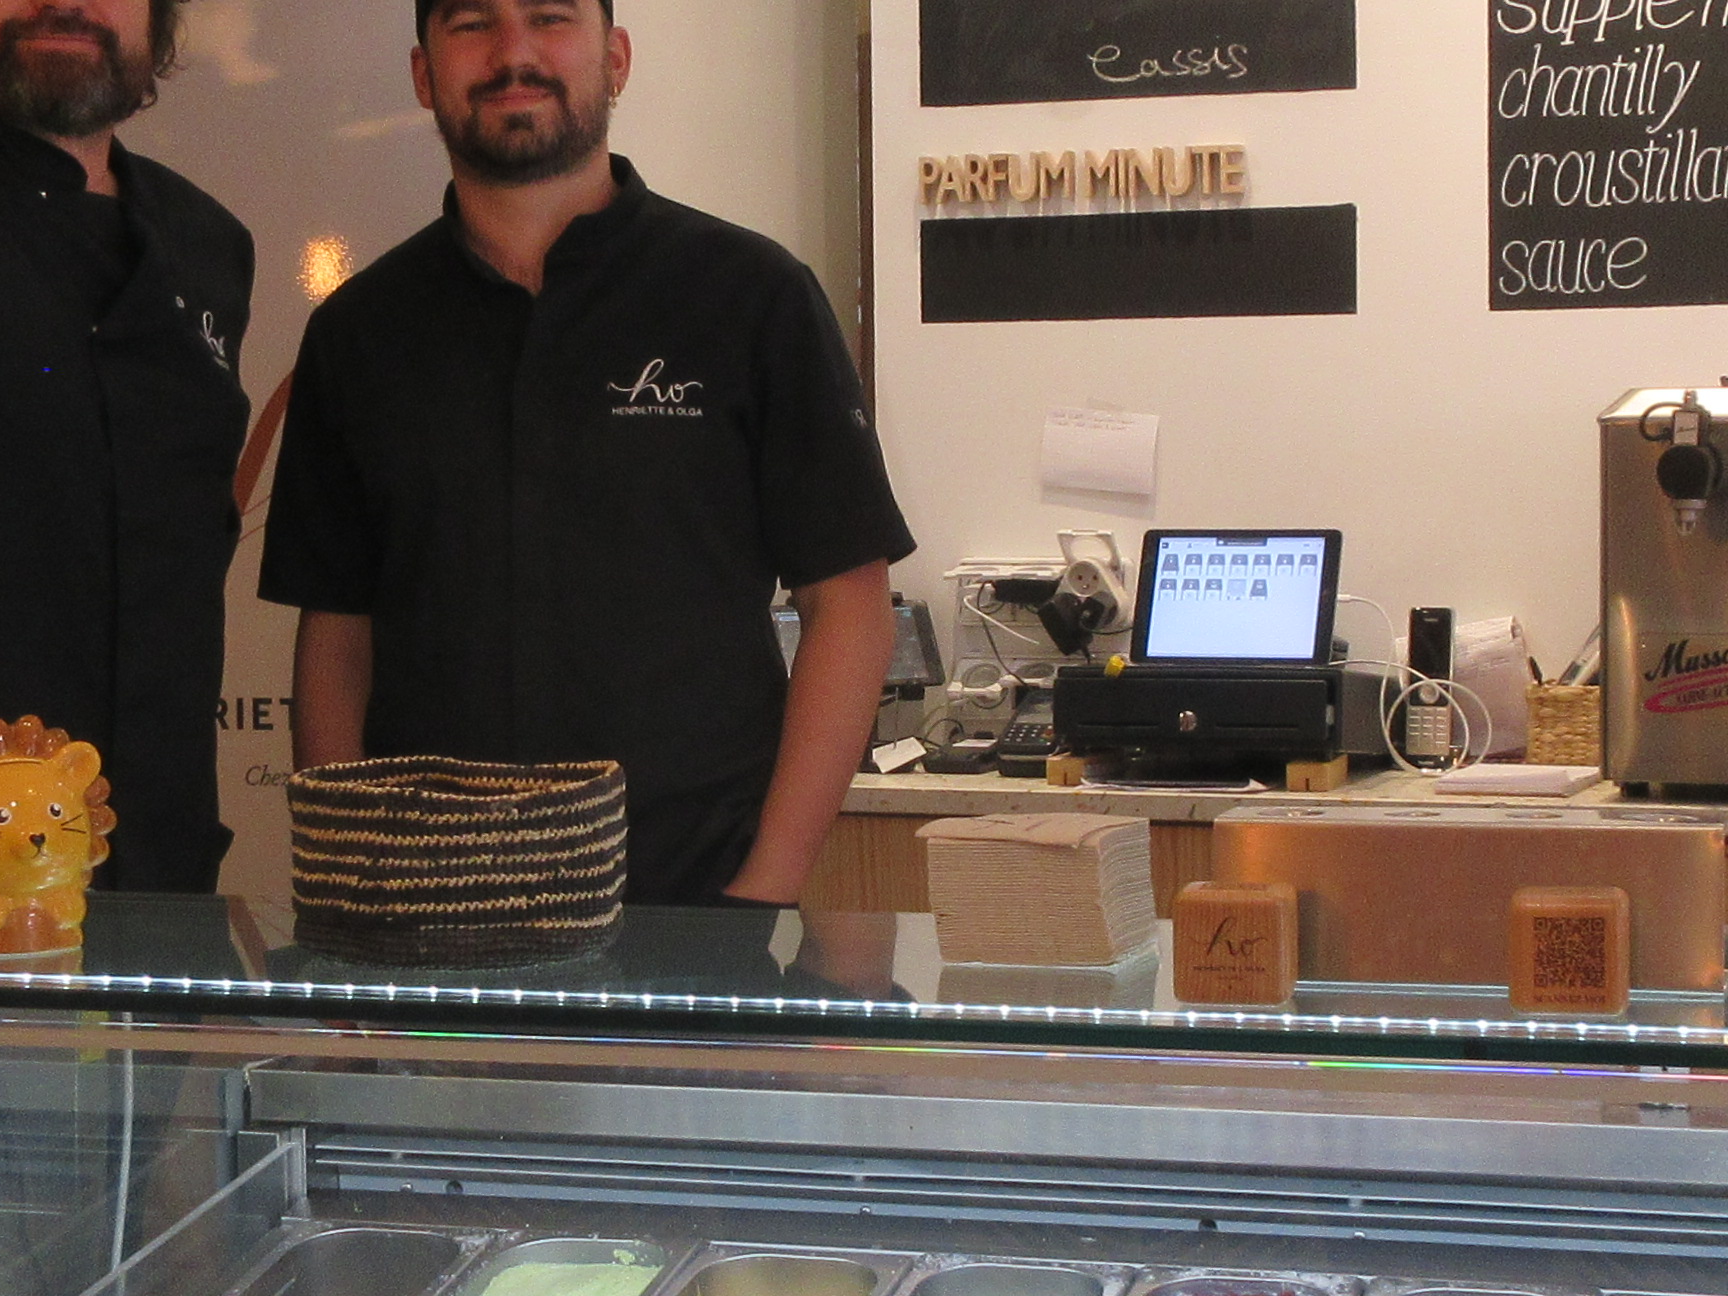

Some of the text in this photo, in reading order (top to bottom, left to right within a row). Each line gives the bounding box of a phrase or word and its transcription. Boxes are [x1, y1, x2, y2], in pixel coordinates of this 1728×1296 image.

[1088, 42, 1248, 83] Cassis
[1498, 43, 1701, 134] chantilly
[918, 144, 1246, 204] PARFUM MINUTE
[1499, 237, 1648, 296] sauce
